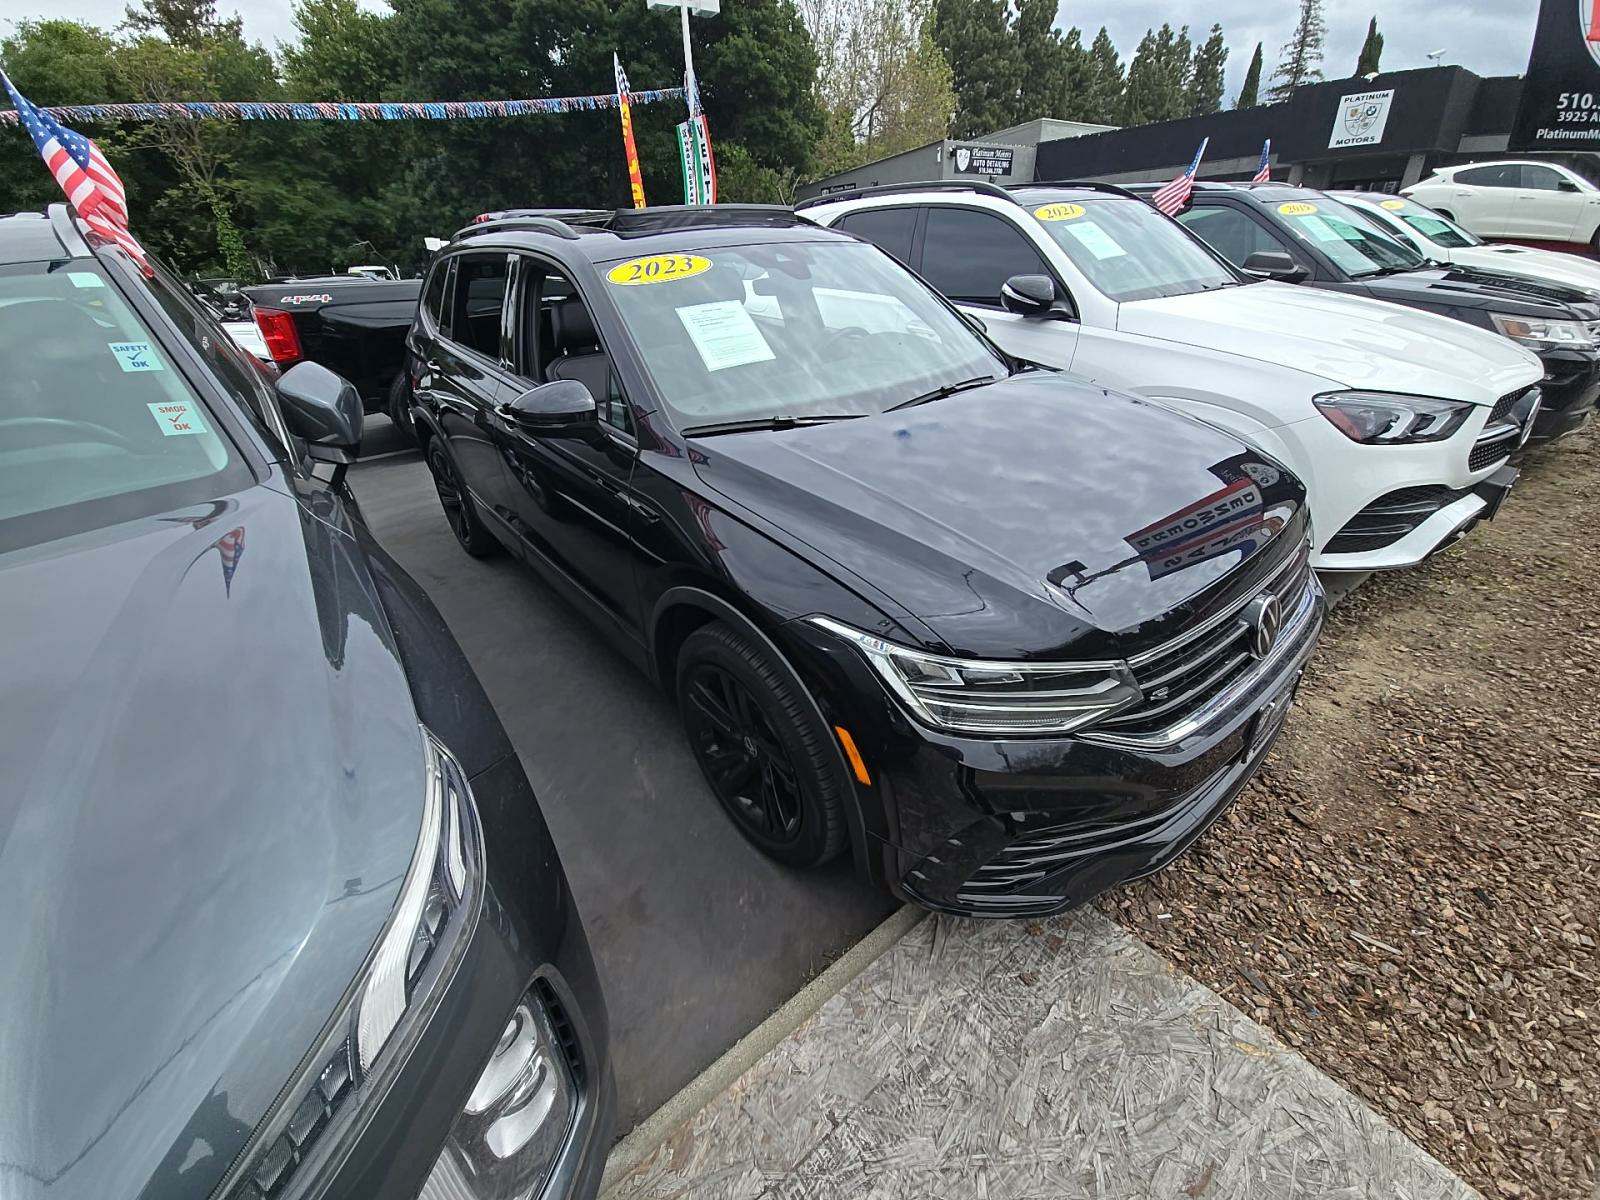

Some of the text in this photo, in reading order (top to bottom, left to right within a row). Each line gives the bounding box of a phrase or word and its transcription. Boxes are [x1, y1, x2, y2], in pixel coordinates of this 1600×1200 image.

[1344, 93, 1389, 103] PLATINUM
[1556, 93, 1600, 109] 510.
[1556, 111, 1600, 122] 3925 A
[1536, 128, 1600, 139] PlatinumM
[1335, 136, 1376, 145] MOTORS
[973, 159, 1009, 168] AUTO DETAILING
[1045, 205, 1075, 218] 2021
[628, 257, 693, 281] 2023
[113, 344, 148, 352] SAFETY
[158, 405, 187, 413] SMOG
